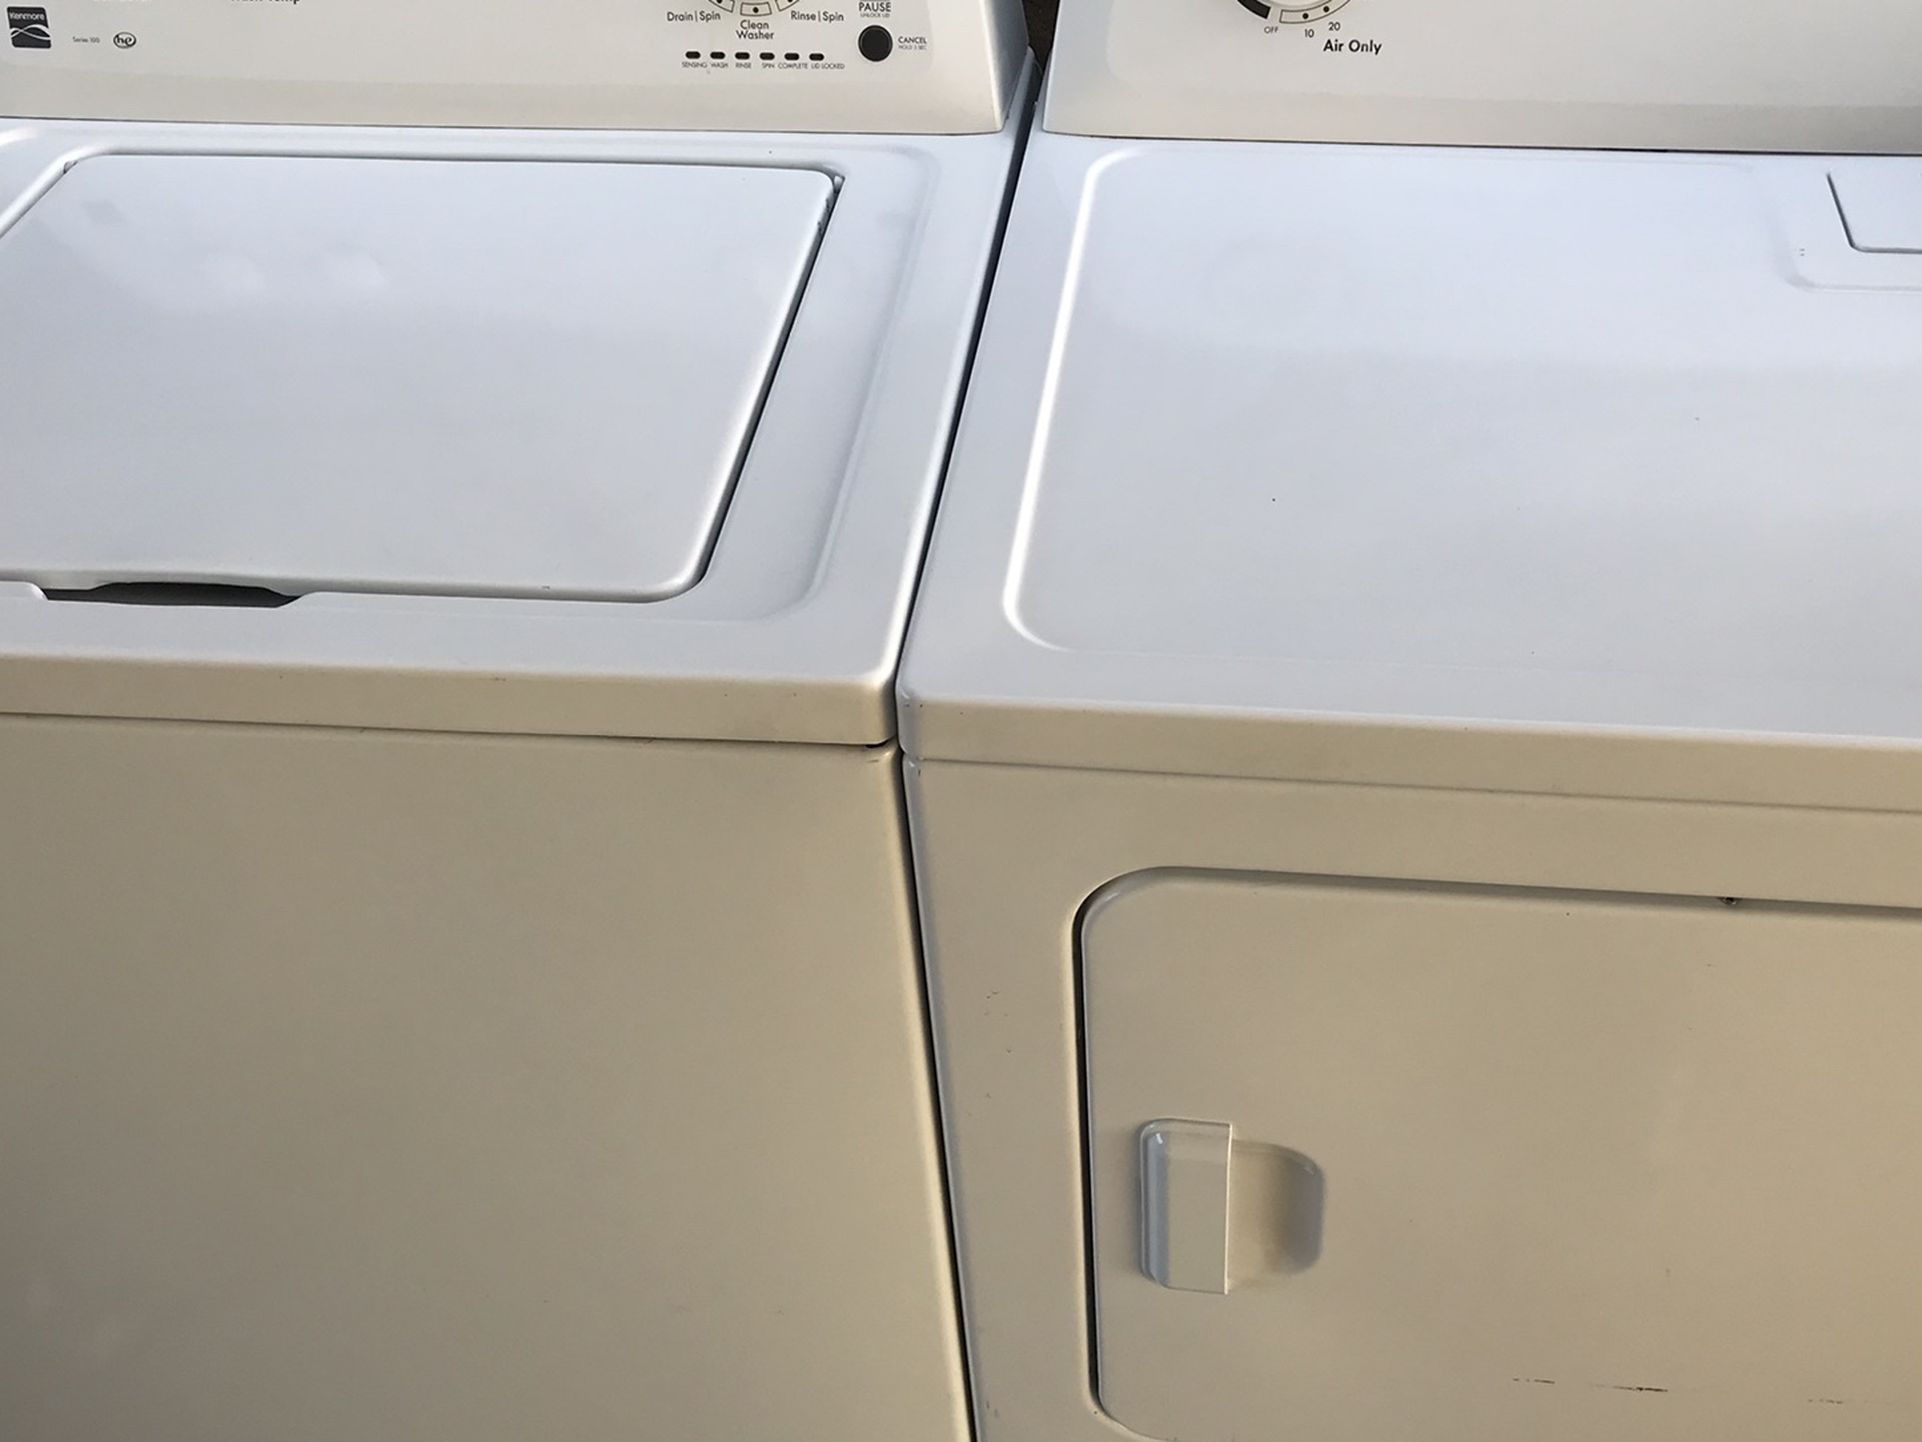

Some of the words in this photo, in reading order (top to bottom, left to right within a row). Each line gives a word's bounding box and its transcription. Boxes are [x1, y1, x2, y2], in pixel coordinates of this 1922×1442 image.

[858, 2, 891, 12] PAUSE
[9, 12, 45, 20] Kenmore
[740, 20, 769, 30] Clean
[1328, 22, 1341, 31] 20
[1264, 26, 1278, 34] OFF
[1304, 29, 1314, 38] 10
[736, 30, 774, 40] Washer
[898, 36, 927, 44] CANCEL
[1323, 39, 1344, 52] Air
[1348, 39, 1382, 55] Only
